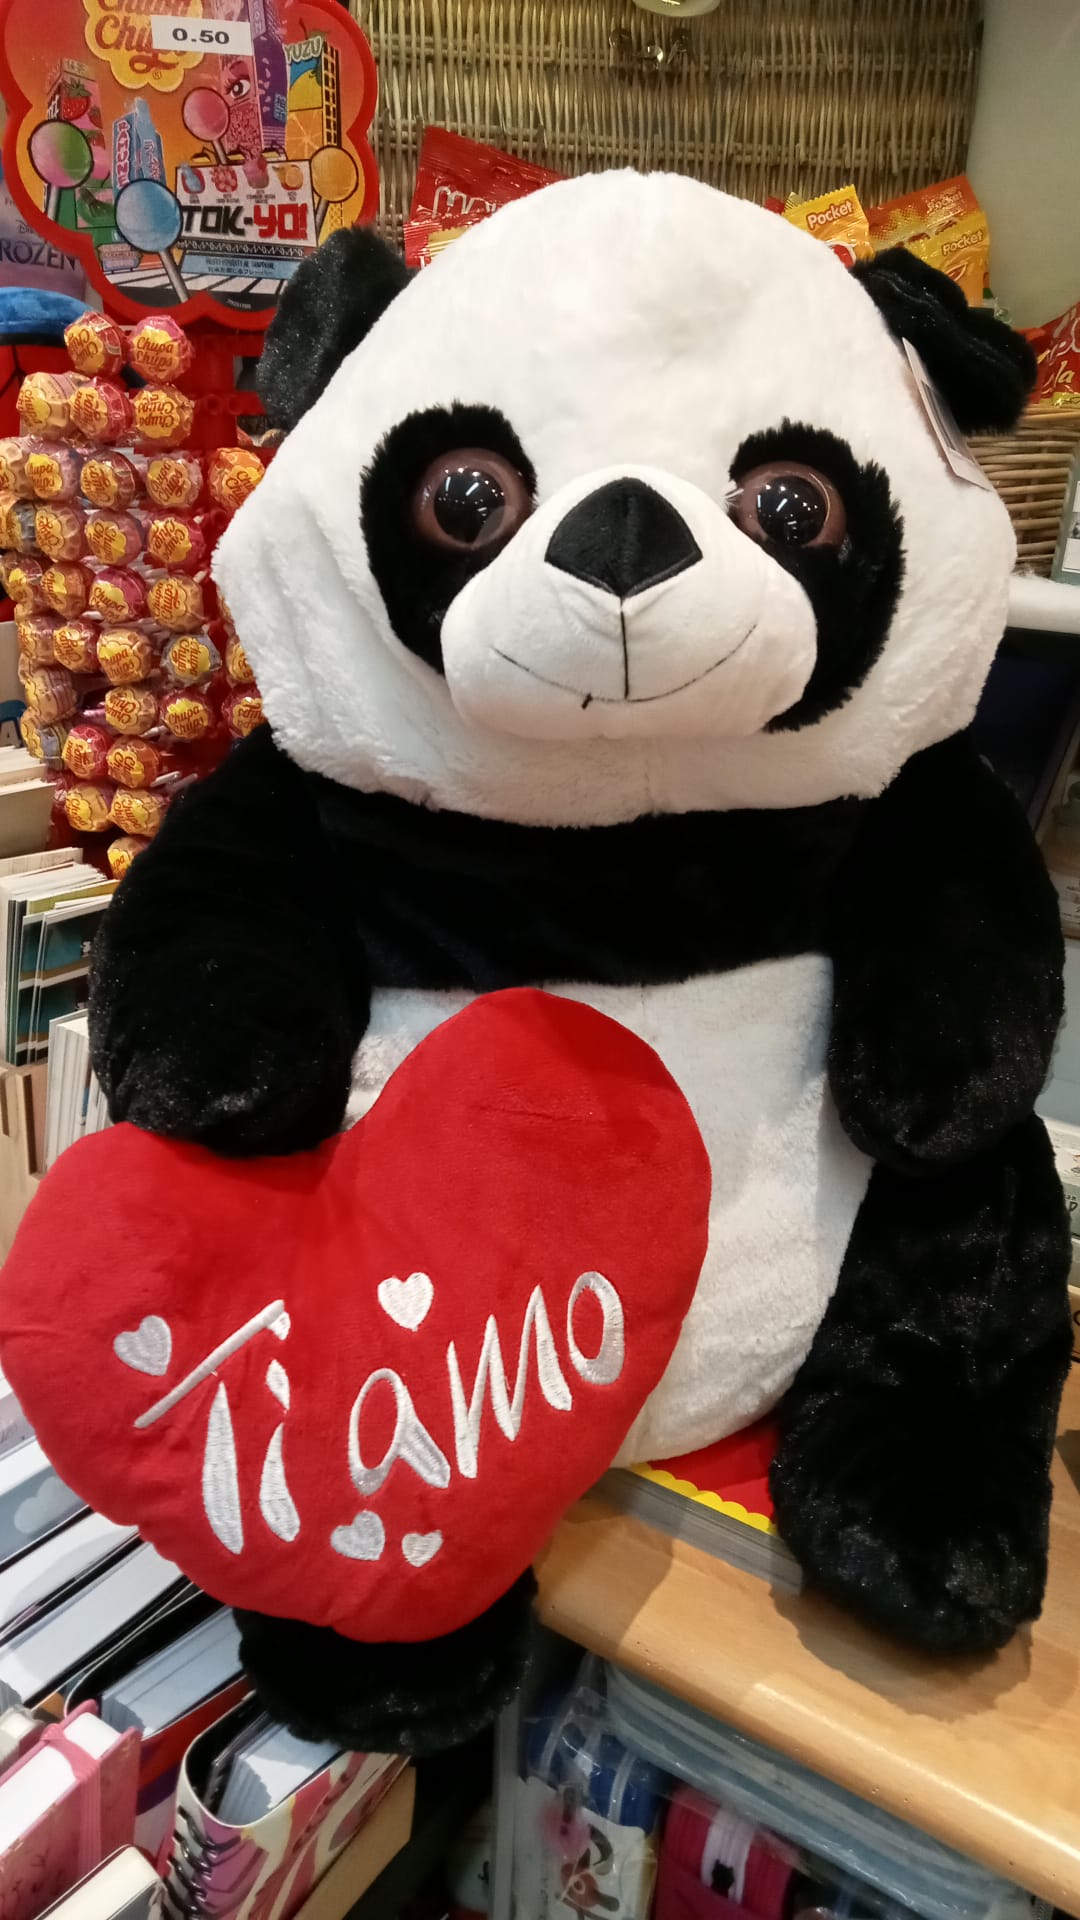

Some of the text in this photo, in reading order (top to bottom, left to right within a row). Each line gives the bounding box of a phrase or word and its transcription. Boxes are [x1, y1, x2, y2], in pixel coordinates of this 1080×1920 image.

[172, 28, 230, 45] 0.50
[285, 36, 322, 63] YUZU
[117, 119, 130, 188] RAMUNE
[182, 203, 308, 240] TOK-YO!
[806, 199, 854, 230] Pocket
[941, 229, 985, 257] Pocket
[137, 336, 175, 353] Chupa
[136, 350, 173, 369] Chups
[151, 461, 171, 492] Chupa
[158, 470, 183, 502] Chups
[94, 586, 125, 612] Chupa
[168, 704, 200, 724] Chupa
[173, 716, 205, 735] Chups
[133, 1270, 625, 1555] Ti amo
